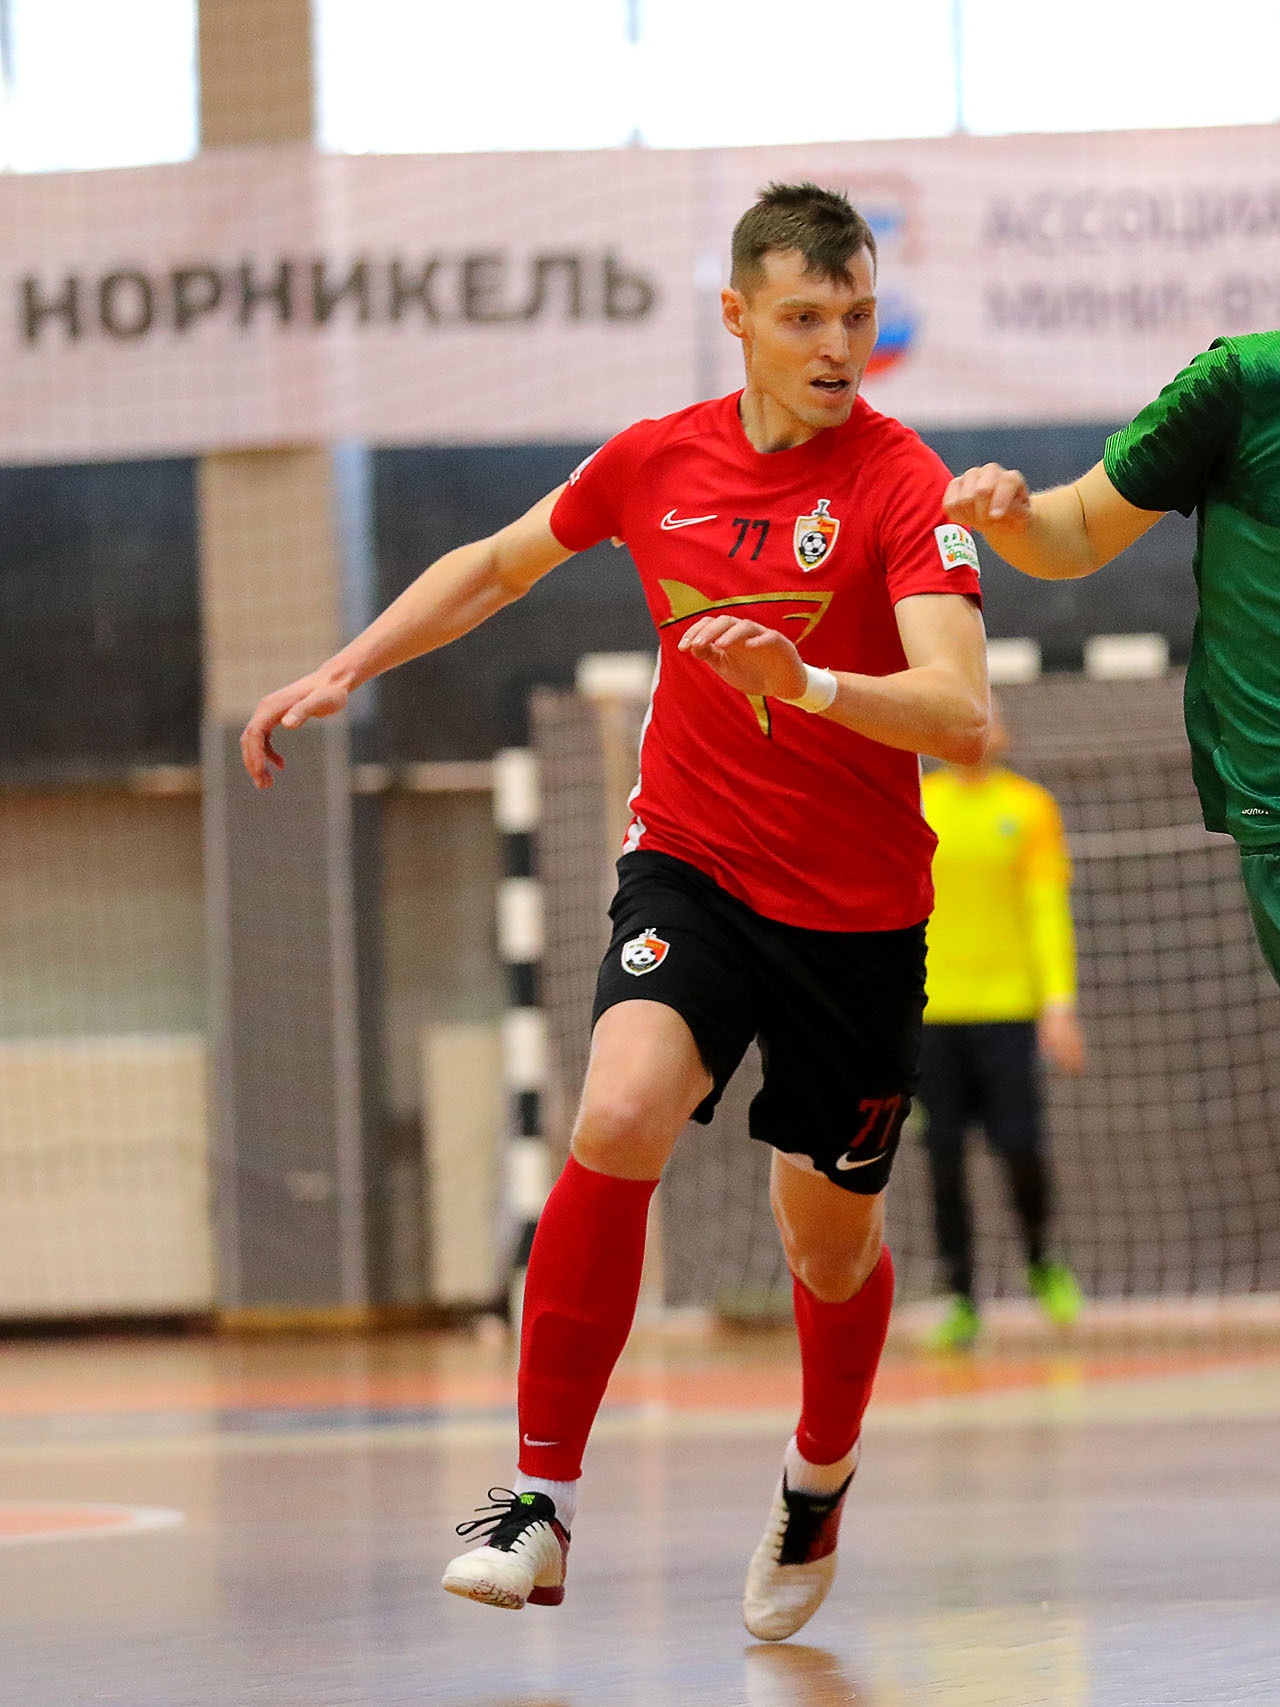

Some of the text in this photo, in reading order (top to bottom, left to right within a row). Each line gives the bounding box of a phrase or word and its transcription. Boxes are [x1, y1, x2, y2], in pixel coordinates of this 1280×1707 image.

[20, 249, 657, 347] НОРНИКЕЛЬ
[728, 518, 770, 561] 77
[850, 1094, 901, 1148] 77
